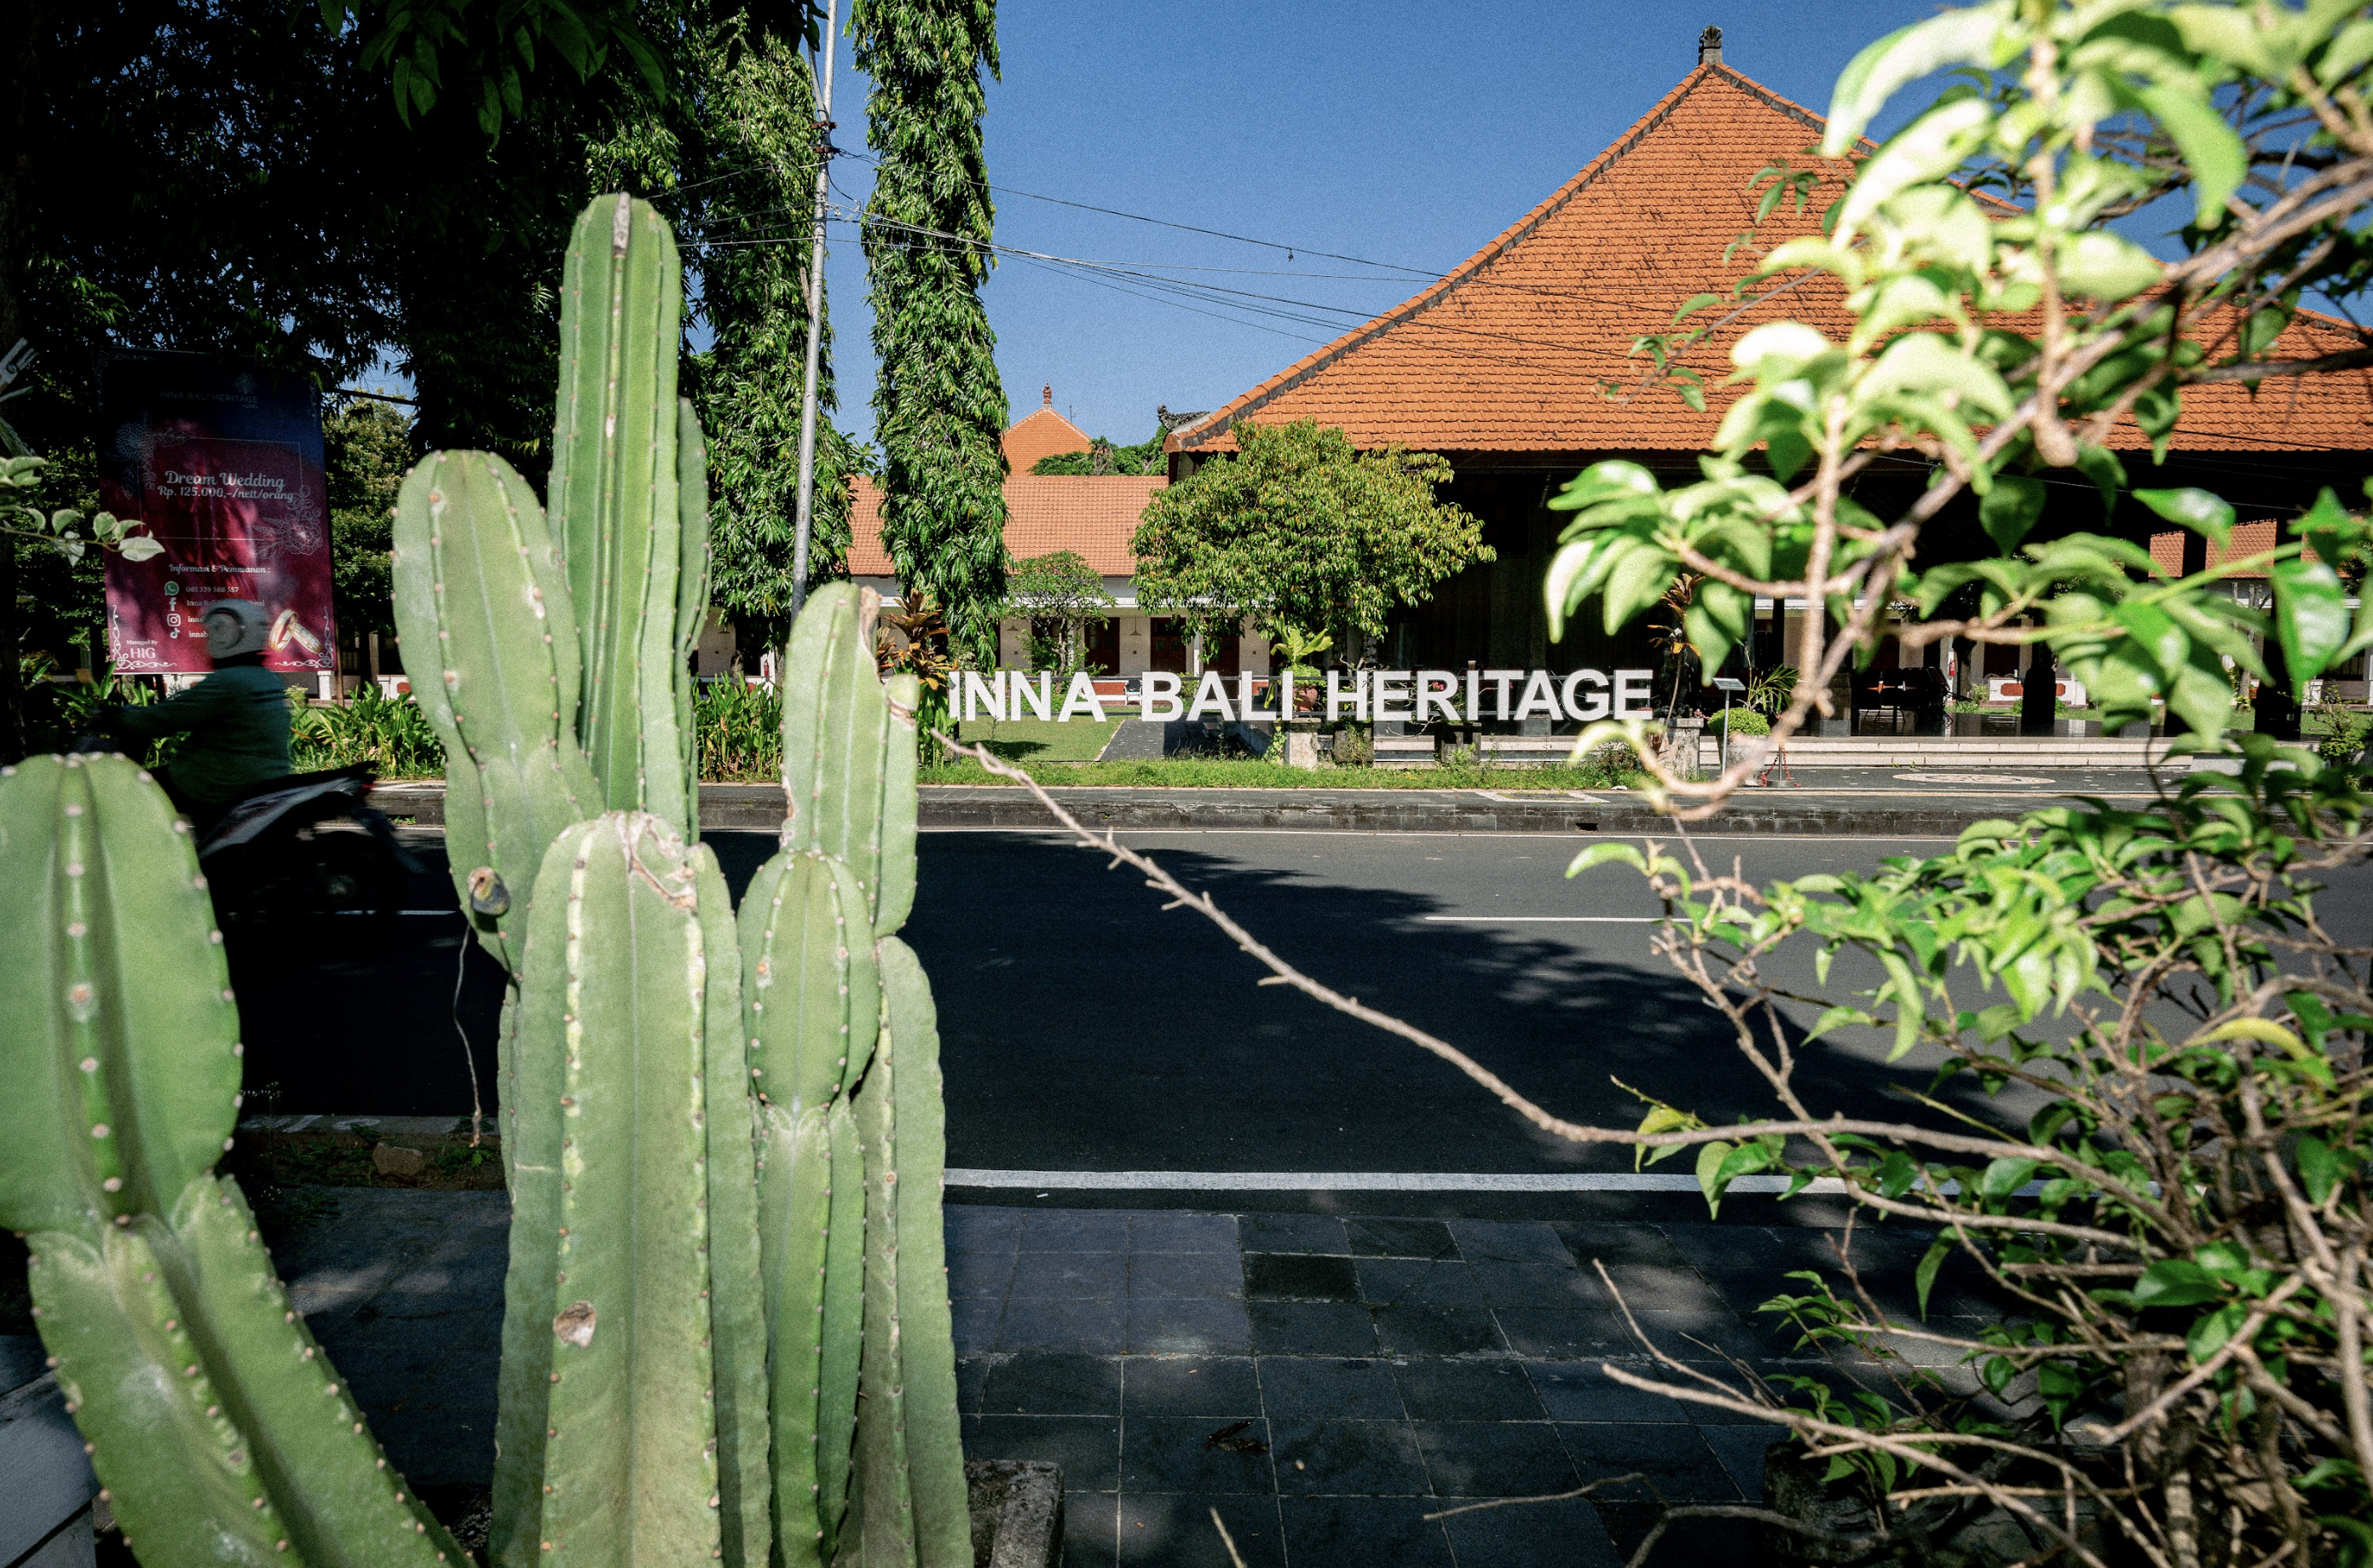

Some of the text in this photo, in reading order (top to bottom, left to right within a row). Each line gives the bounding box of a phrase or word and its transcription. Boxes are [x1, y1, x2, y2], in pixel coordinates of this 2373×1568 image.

[212, 394, 257, 404] HERITAGE
[165, 470, 286, 493] Dream Wedding
[157, 486, 176, 499] Rp.
[169, 563, 210, 575] Informasi
[130, 648, 156, 659] HIG
[948, 668, 1654, 723] INNA BALI HERITAGE
